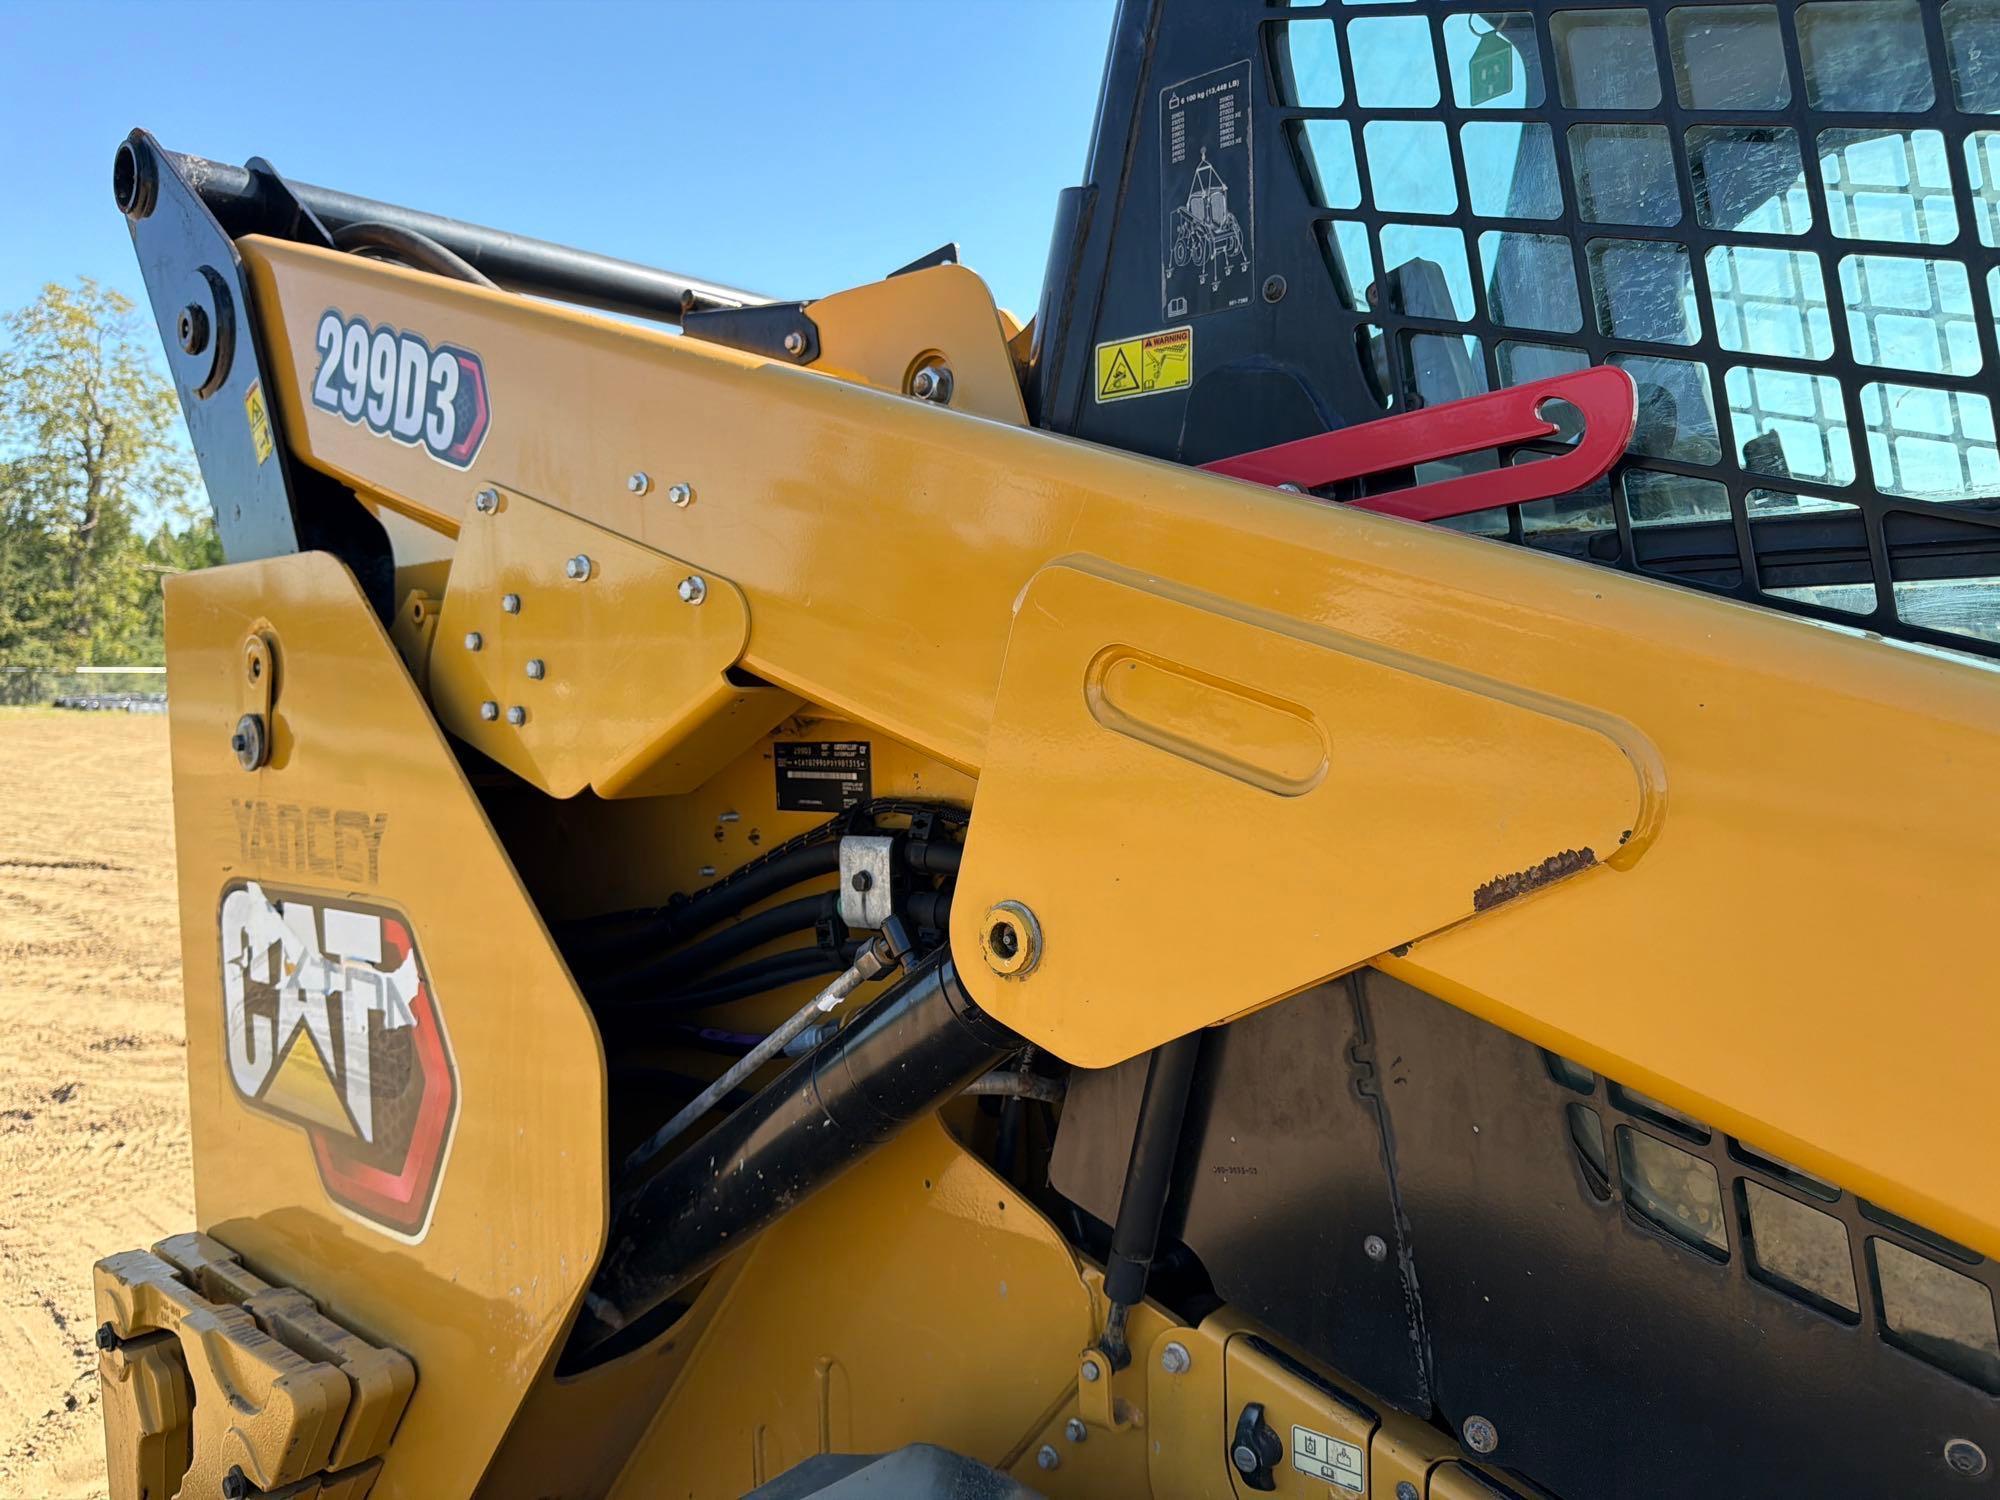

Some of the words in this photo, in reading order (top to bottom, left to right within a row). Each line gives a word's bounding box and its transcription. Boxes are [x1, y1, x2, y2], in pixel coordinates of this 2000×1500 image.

[1186, 93, 1196, 103] 100
[1197, 91, 1205, 99] kg
[1228, 79, 1240, 88] LB)
[1153, 332, 1188, 345] WARNING
[314, 315, 459, 451] 299D3
[221, 884, 384, 1144] CAT
